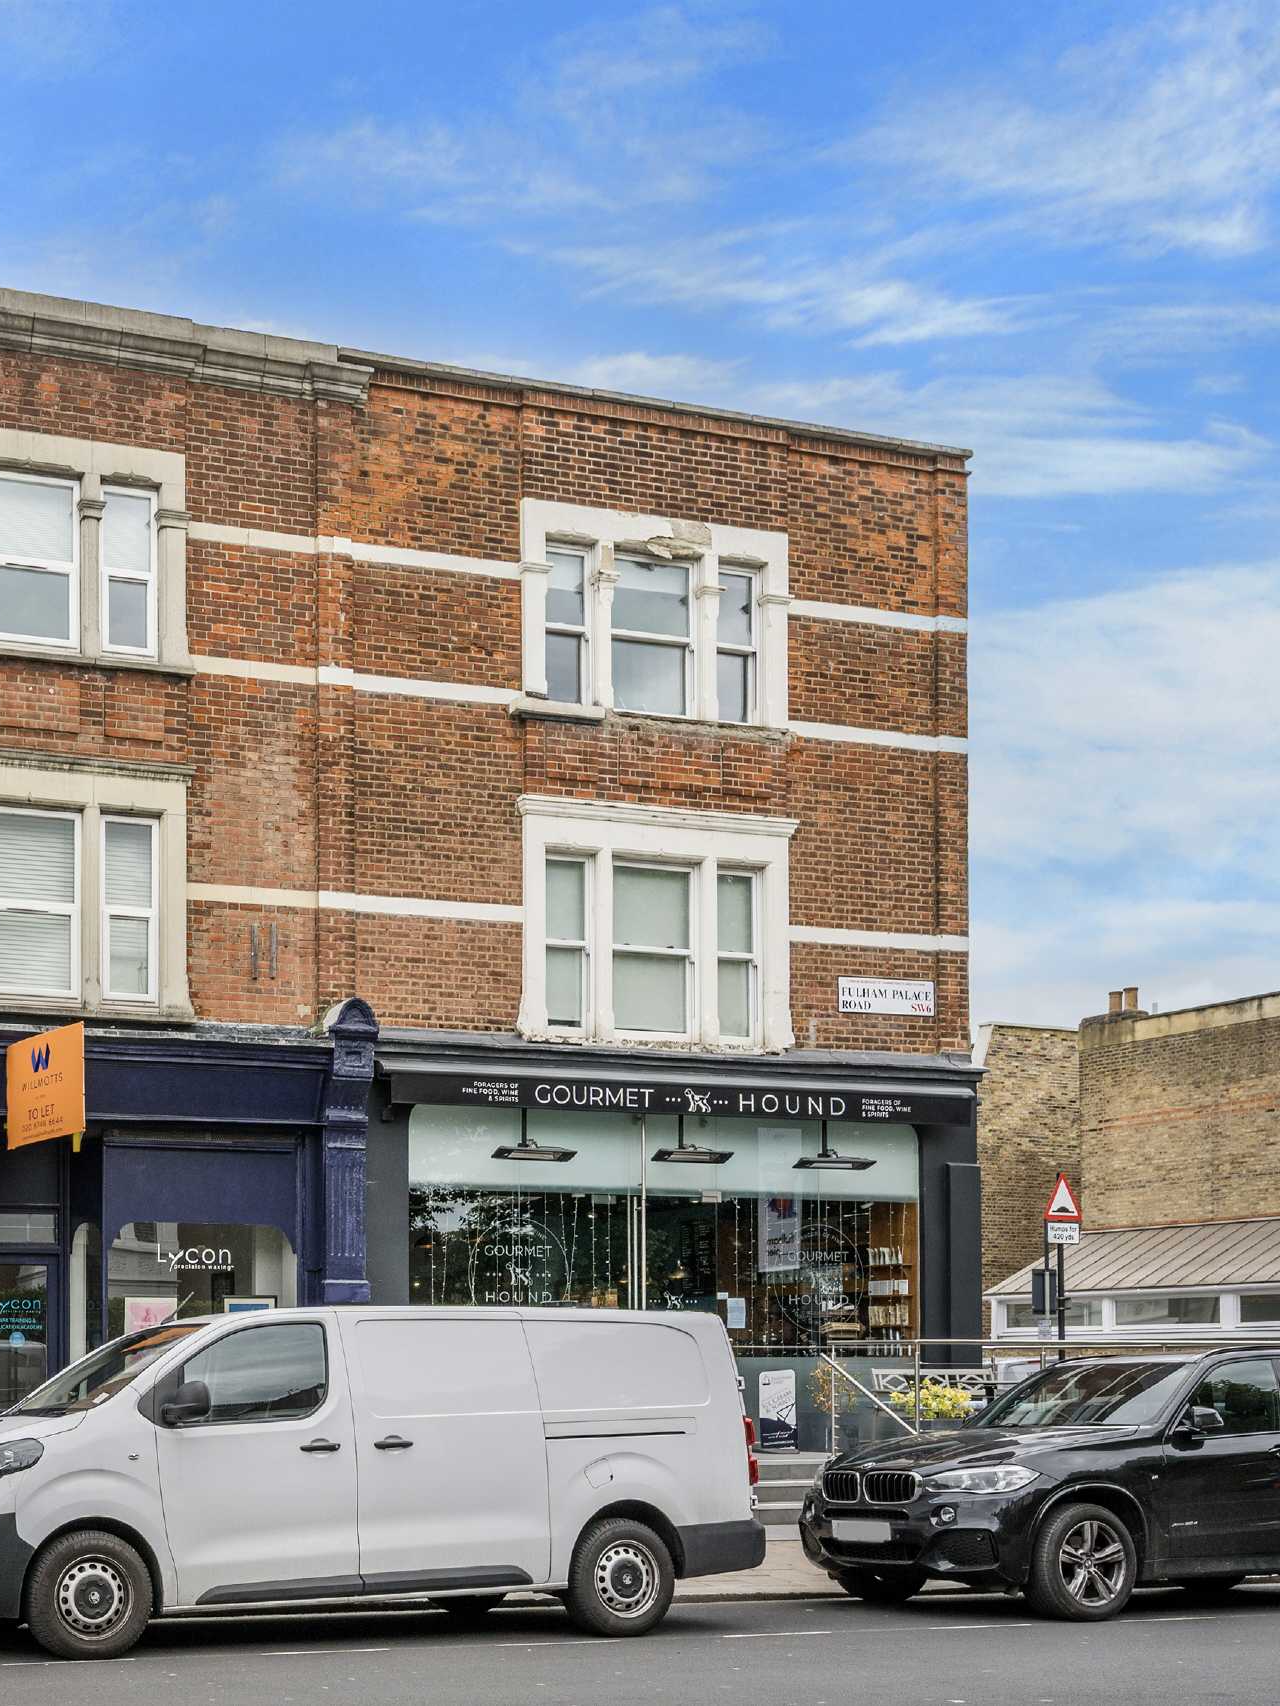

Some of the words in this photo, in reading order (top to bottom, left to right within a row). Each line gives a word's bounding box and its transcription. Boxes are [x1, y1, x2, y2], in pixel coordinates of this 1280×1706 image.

[841, 986, 888, 999] FULHAM
[892, 989, 932, 1001] PALACE
[841, 999, 872, 1010] ROAD
[911, 1003, 932, 1013] SW6
[21, 1071, 64, 1092] WILLMOTTS
[473, 1081, 509, 1089] FORAGERS
[462, 1087, 479, 1095] FINE
[479, 1088, 500, 1096] FOOD,
[494, 1095, 519, 1103] SPIRITS
[534, 1083, 655, 1109] GOURMET
[738, 1093, 847, 1117] HOUND
[861, 1098, 893, 1106] FORAGERS
[27, 1107, 39, 1121] TO
[40, 1103, 55, 1119] LET
[157, 1242, 232, 1272] Lycon
[484, 1244, 553, 1258] GOURMET
[787, 1251, 849, 1262] GOURMET
[484, 1290, 553, 1303] HOUND
[788, 1294, 849, 1306] HOUND
